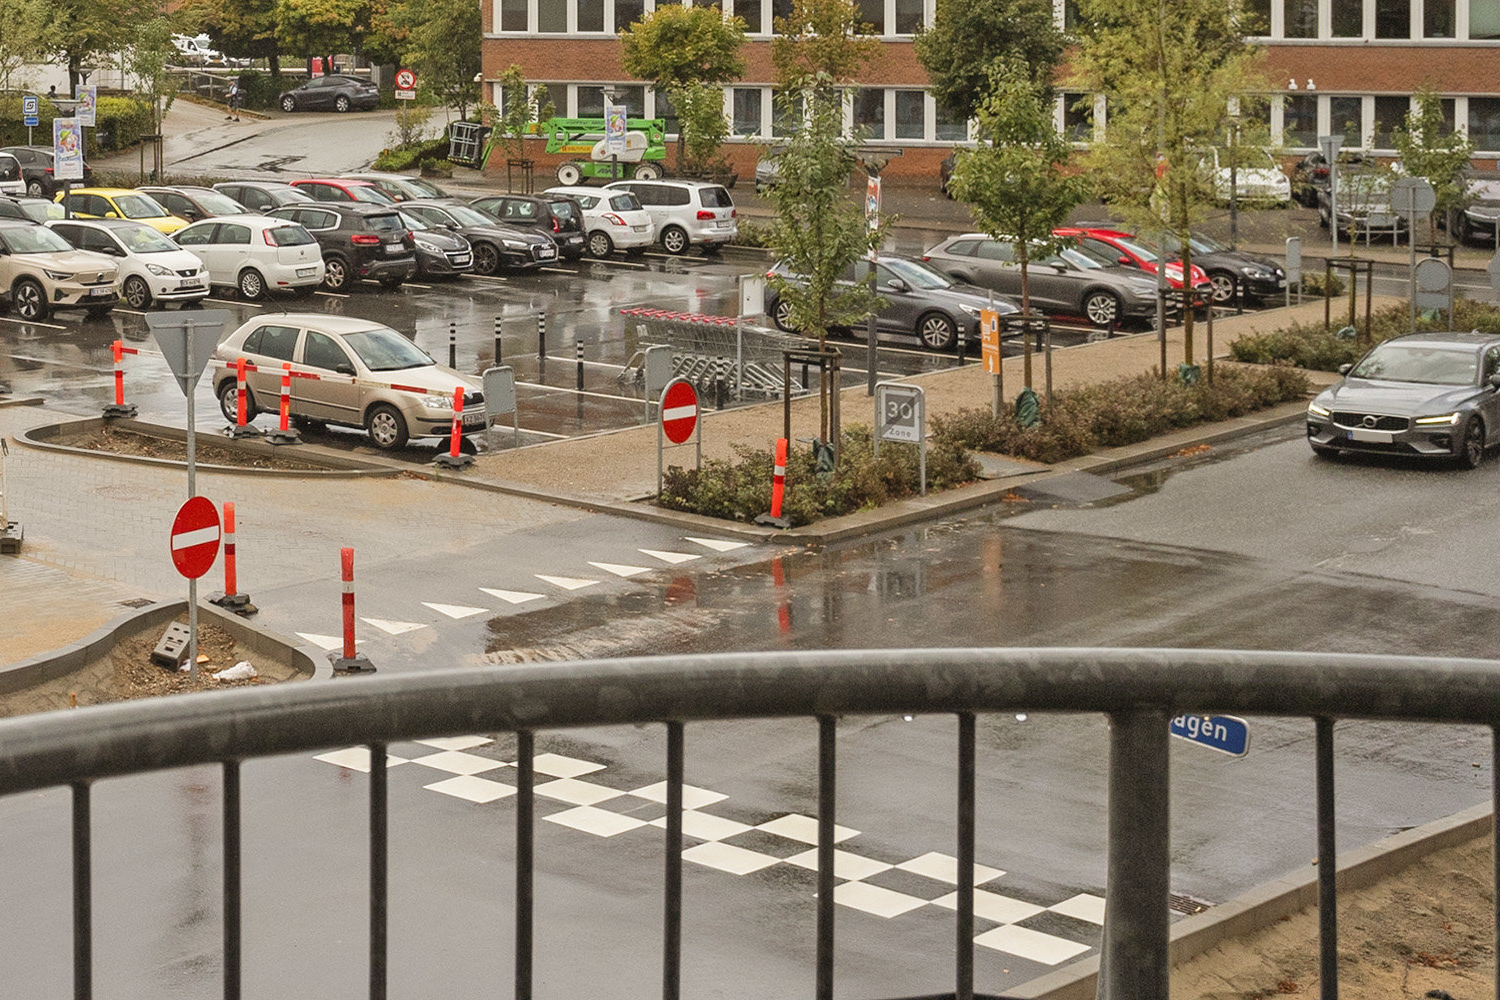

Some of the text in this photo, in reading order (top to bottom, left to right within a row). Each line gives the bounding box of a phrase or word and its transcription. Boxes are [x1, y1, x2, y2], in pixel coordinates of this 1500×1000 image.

[887, 400, 912, 419] 30
[890, 428, 911, 438] Zone
[1170, 714, 1227, 742] agen
